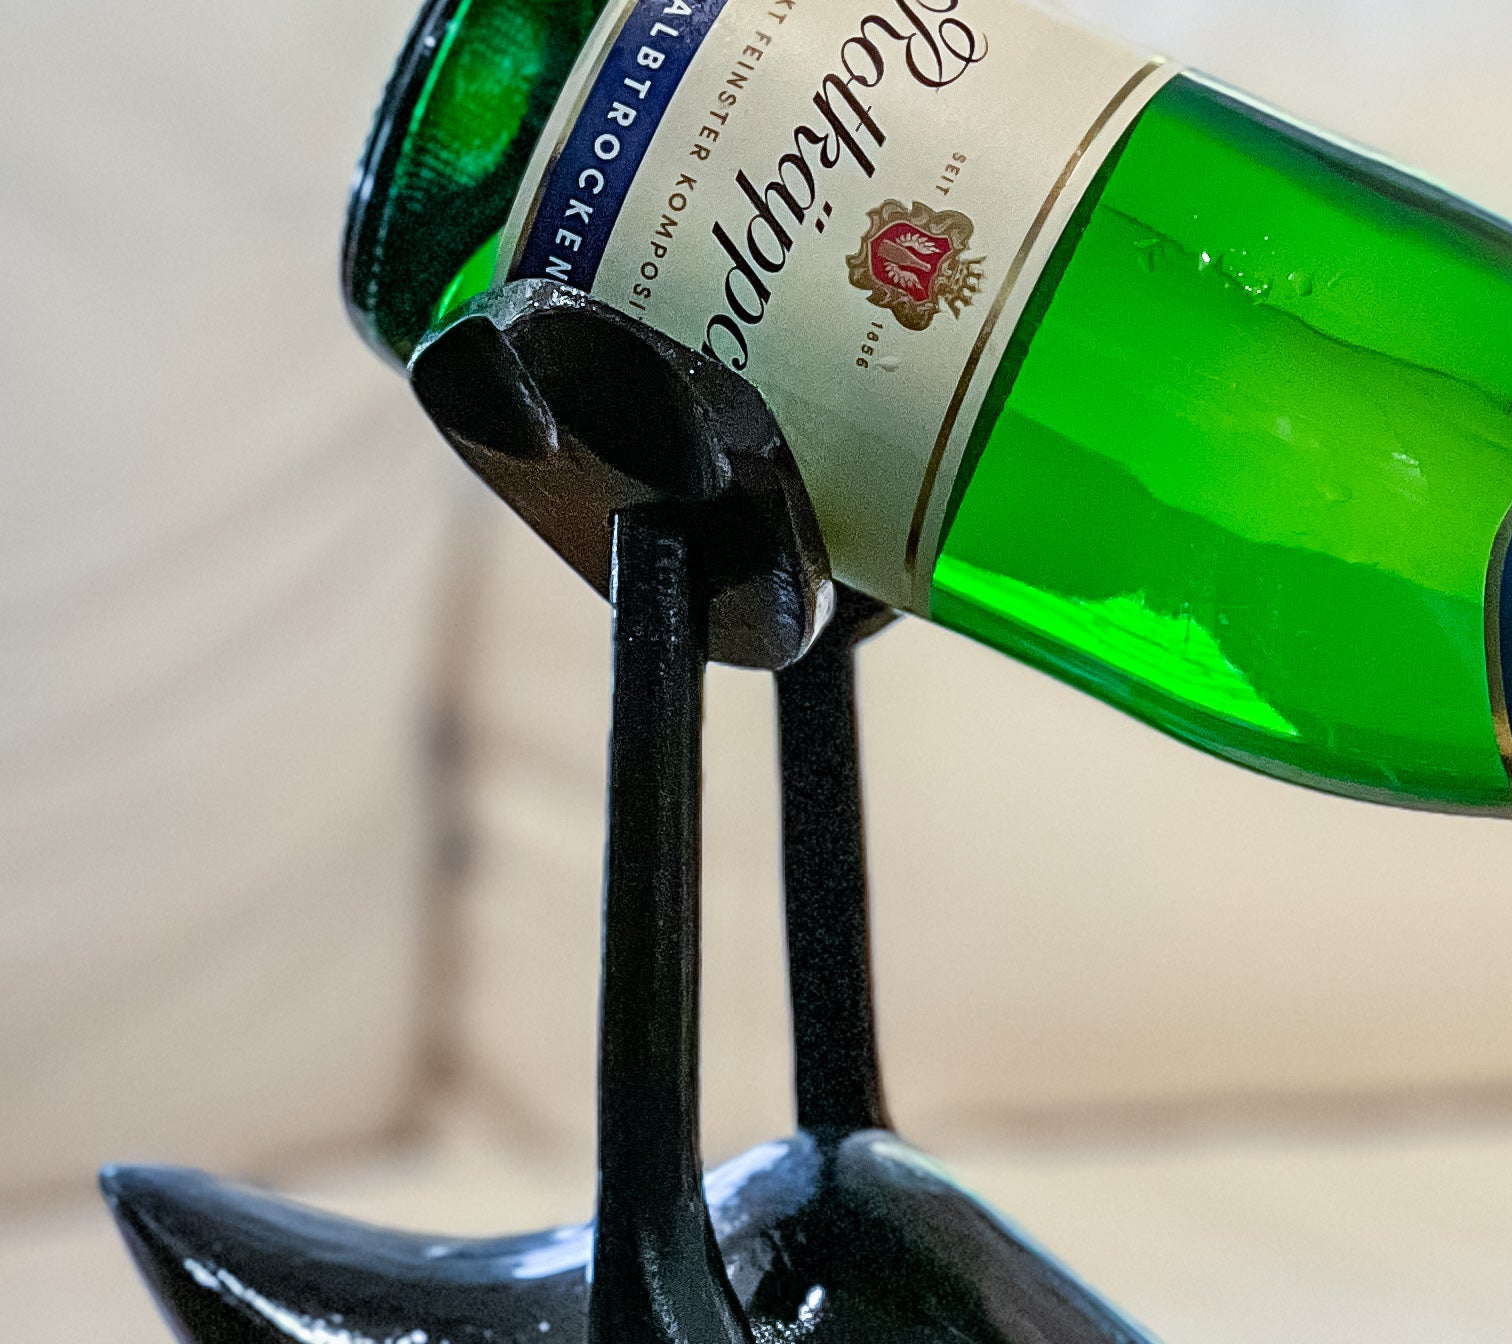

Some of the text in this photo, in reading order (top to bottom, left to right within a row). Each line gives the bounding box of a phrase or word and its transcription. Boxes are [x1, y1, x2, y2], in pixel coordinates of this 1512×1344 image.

[689, 30, 772, 161] FEINSTER
[935, 152, 967, 196] SEIT
[628, 172, 698, 320] KOMPOSI
[856, 322, 884, 369] 1856
